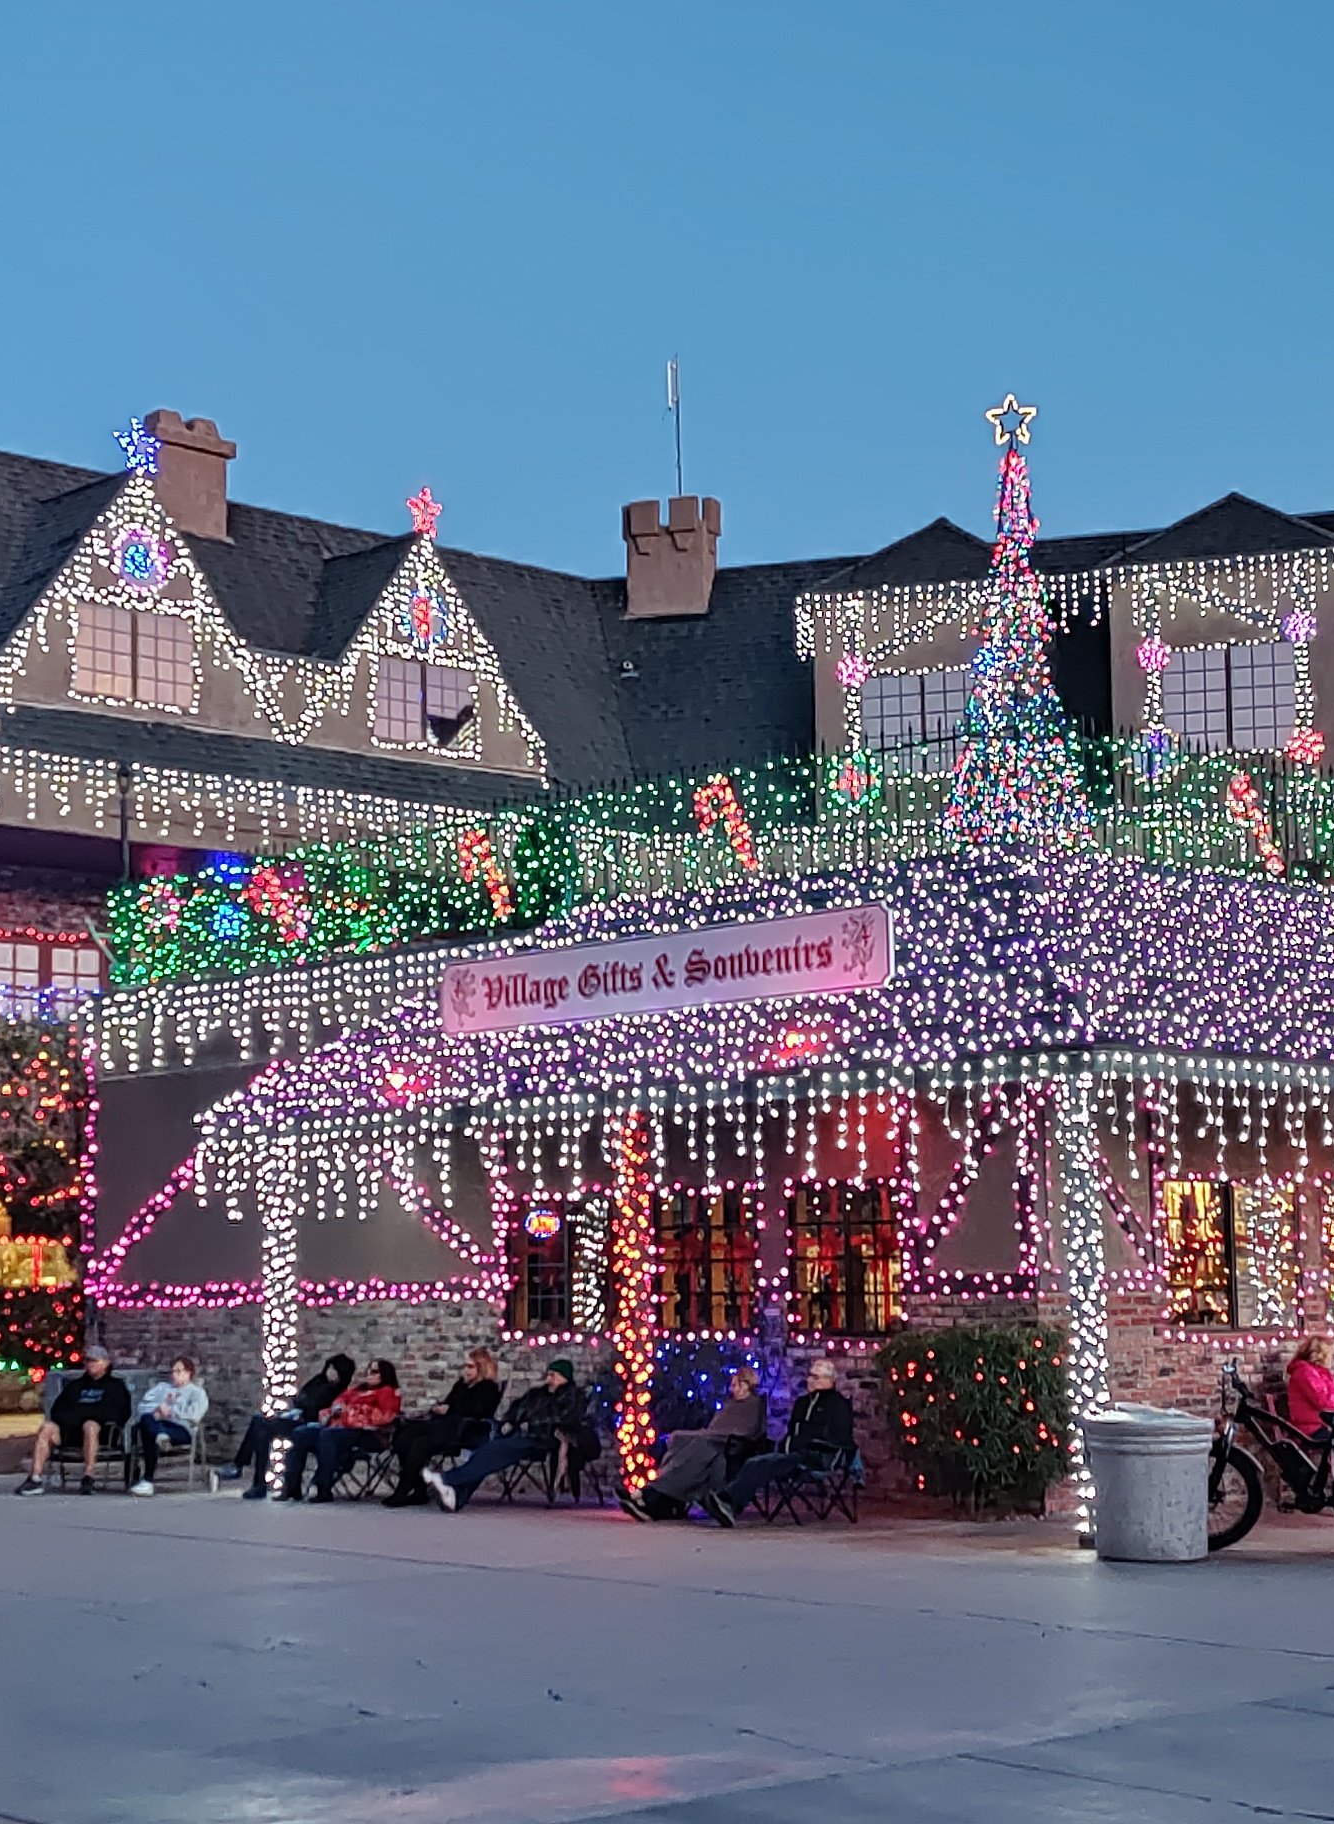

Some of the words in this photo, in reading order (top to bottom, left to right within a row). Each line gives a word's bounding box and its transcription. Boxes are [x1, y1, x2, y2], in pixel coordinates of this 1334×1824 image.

[482, 972, 570, 1011] Village
[578, 961, 643, 998] Gifts
[652, 953, 676, 991] &
[684, 935, 834, 988] Souvenirs
